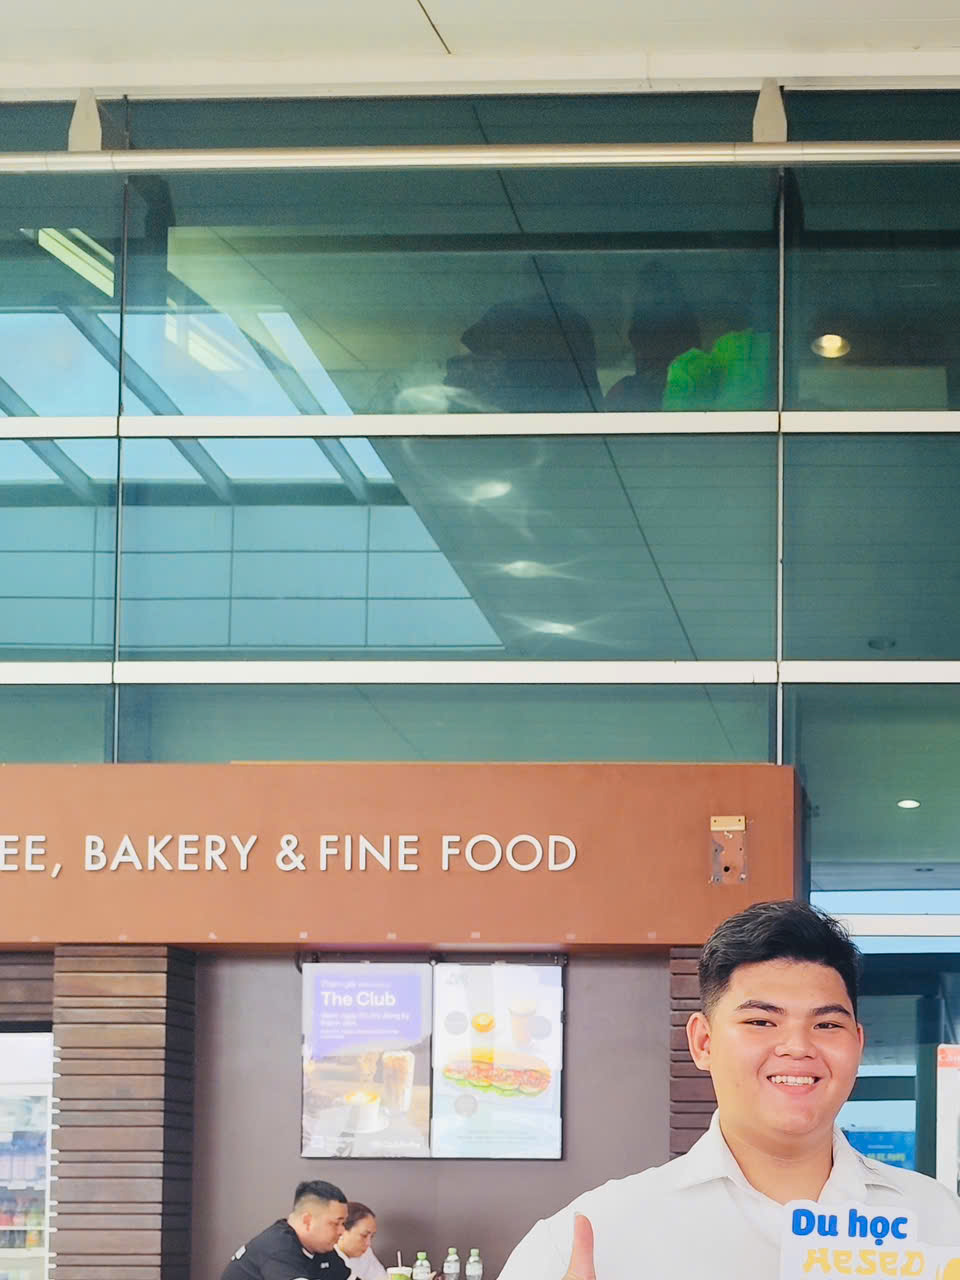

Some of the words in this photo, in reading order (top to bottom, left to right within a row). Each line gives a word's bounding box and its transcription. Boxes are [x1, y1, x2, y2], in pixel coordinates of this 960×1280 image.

[85, 835, 257, 871] BAKERY
[275, 834, 306, 871] &
[320, 835, 419, 871] FINE
[442, 834, 576, 871] FOOD
[321, 992, 352, 1006] The
[356, 992, 396, 1006] Club
[792, 1209, 838, 1236] Du
[848, 1209, 908, 1245] học
